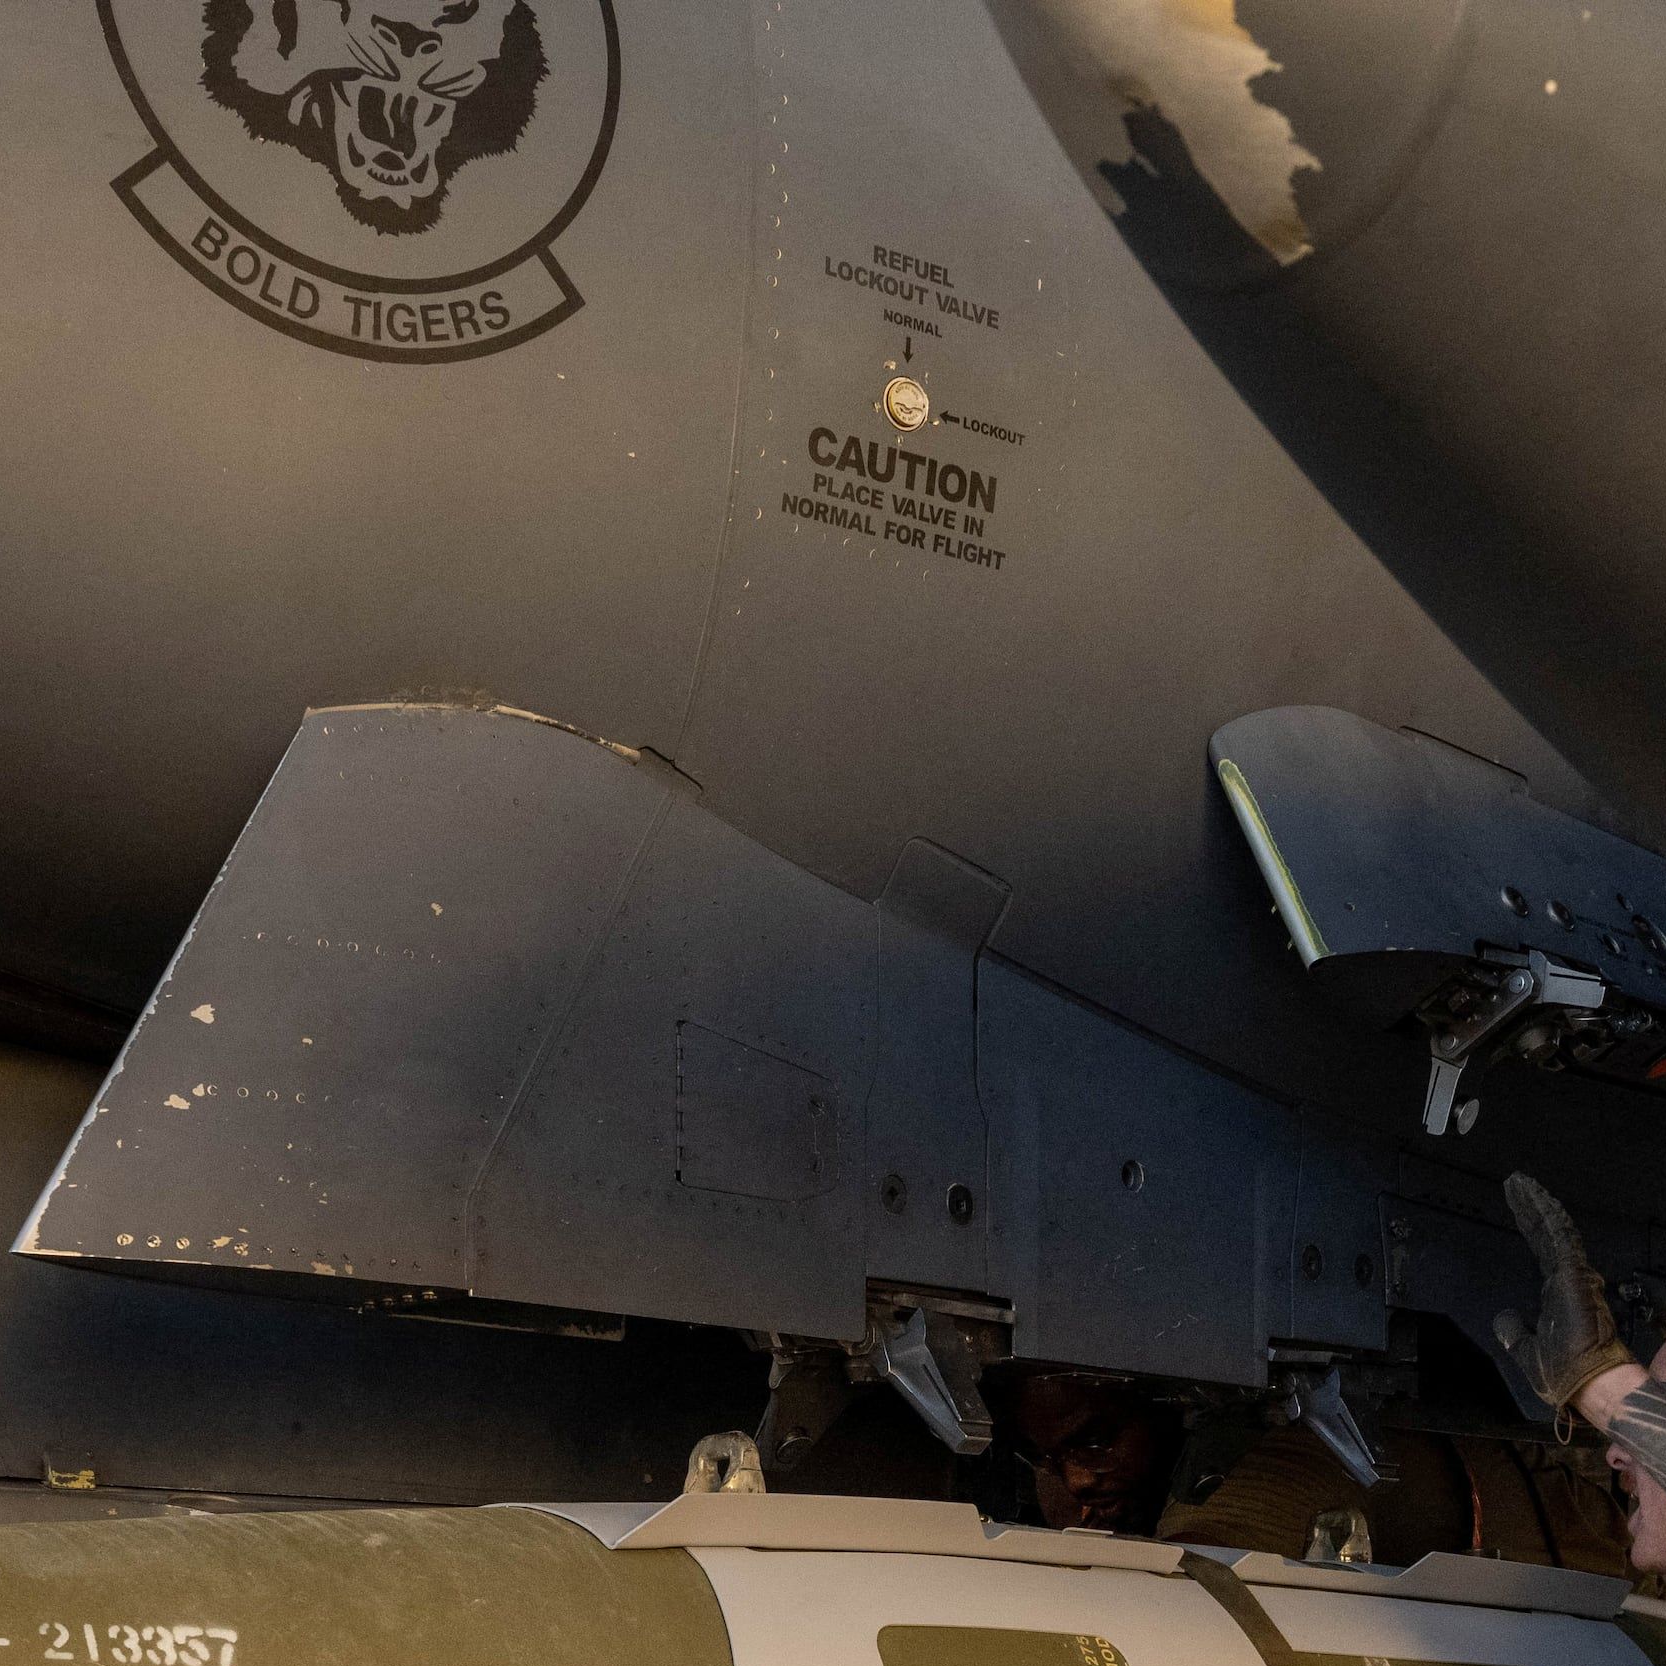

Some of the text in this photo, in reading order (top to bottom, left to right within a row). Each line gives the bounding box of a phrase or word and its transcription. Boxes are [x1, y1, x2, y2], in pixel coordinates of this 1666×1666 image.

[191, 216, 510, 342] BOLD TIGERS
[825, 255, 1000, 330] LOCKOUT VALVE
[873, 245, 955, 289] REFUEL
[883, 308, 943, 338] NORMAL
[963, 416, 1026, 446] LOCKOUT
[808, 427, 998, 514] CAUTION
[812, 472, 985, 538] PLACE VALVE IN
[781, 492, 1006, 570] NORMAL FOR FLIGHT
